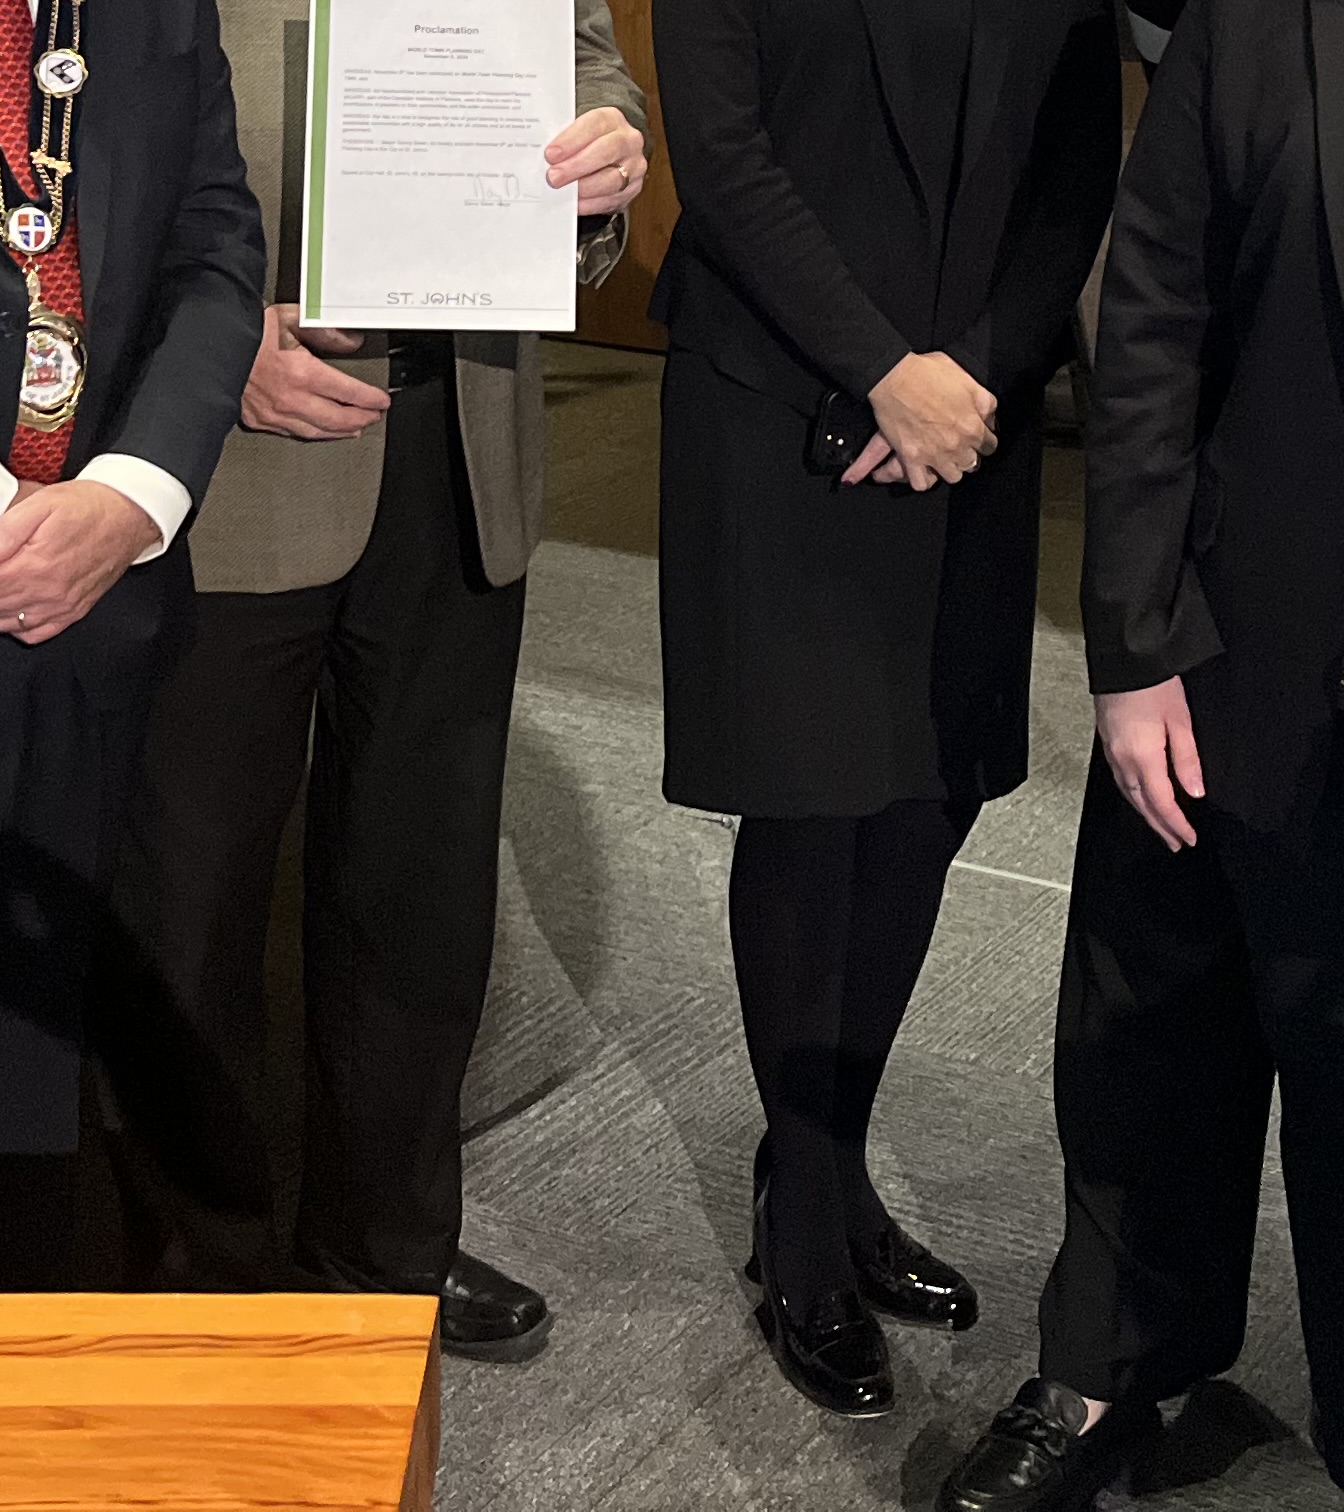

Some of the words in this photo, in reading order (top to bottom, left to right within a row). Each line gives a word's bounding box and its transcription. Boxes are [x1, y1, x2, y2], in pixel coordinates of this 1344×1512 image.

[414, 24, 480, 35] Proclamation
[386, 292, 414, 305] ST.
[420, 291, 493, 306] JOHN'S
